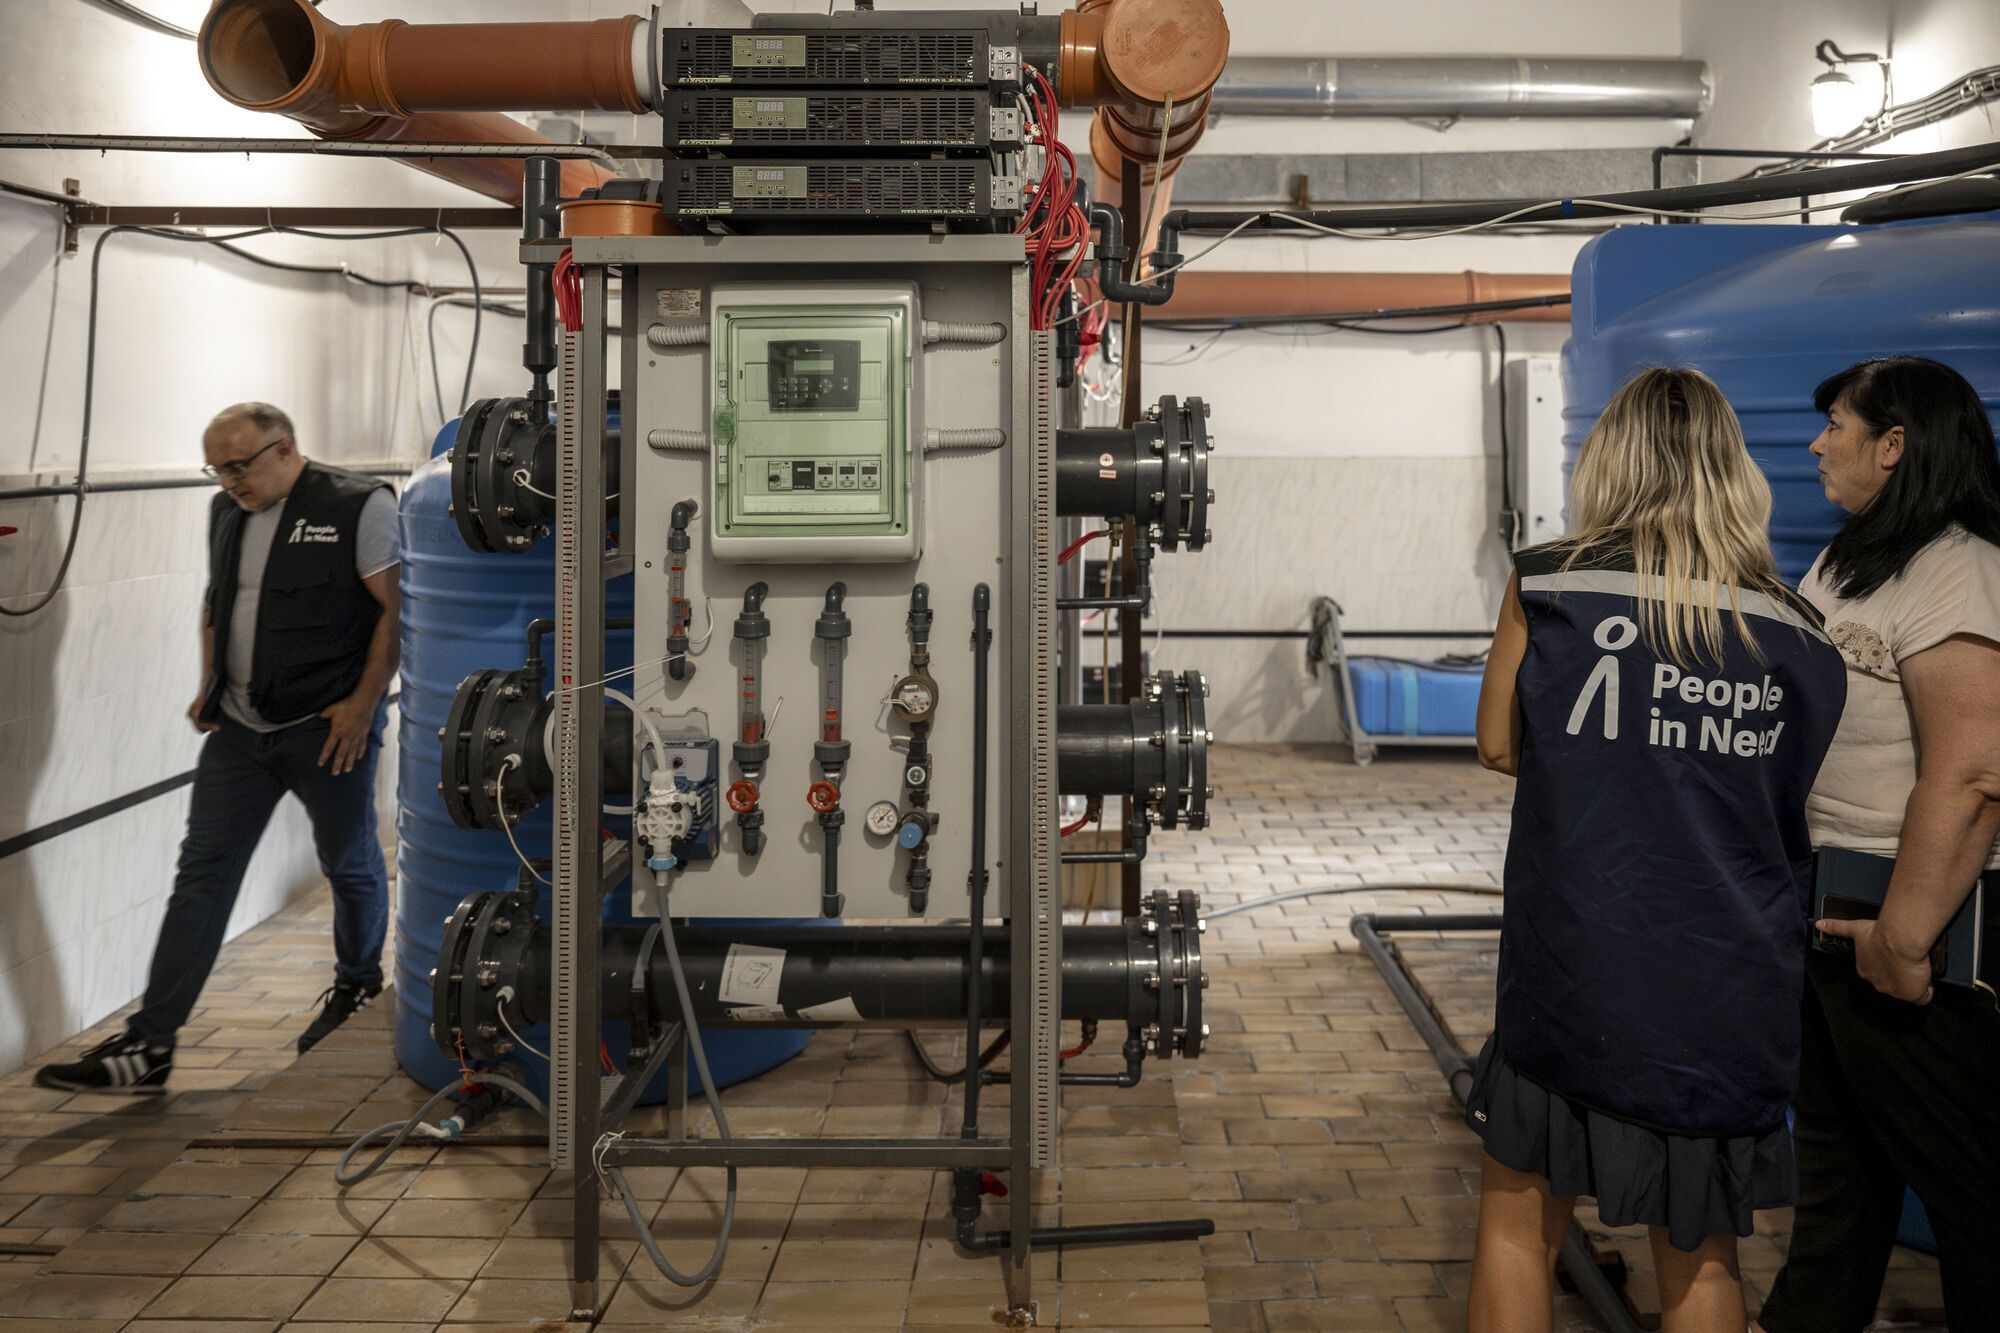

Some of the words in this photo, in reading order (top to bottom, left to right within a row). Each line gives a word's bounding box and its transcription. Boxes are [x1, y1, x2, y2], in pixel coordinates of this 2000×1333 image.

[303, 533, 313, 542] in
[314, 533, 340, 543] Need
[304, 525, 337, 536] People
[1652, 663, 1783, 719] People
[1649, 707, 1687, 749] in
[1699, 715, 1785, 757] Need
